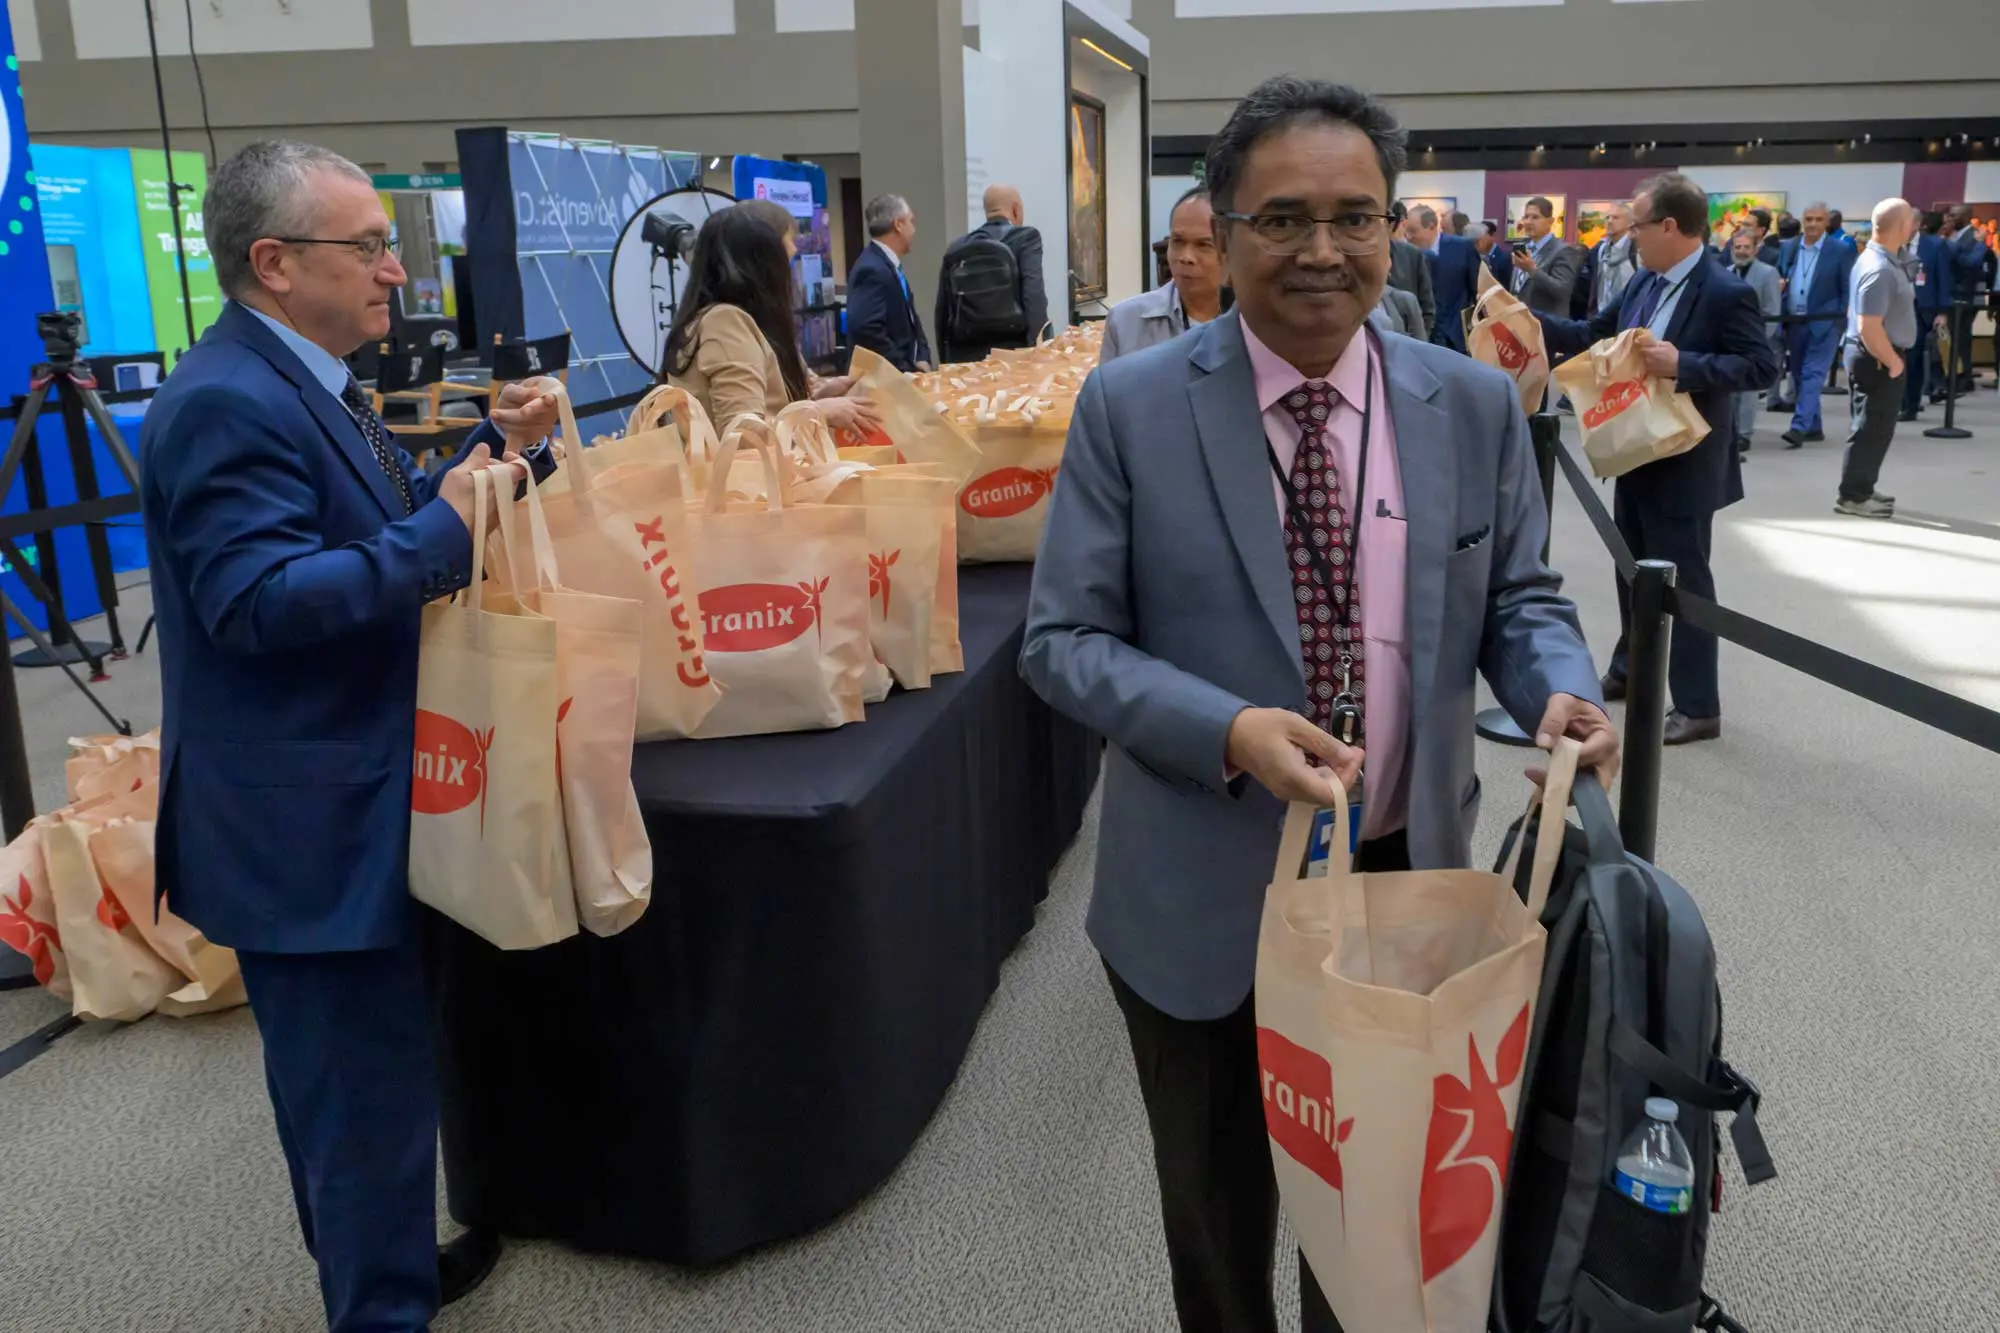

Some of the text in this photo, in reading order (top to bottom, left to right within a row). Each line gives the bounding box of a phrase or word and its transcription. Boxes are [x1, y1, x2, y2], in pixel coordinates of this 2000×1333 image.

[968, 478, 1034, 508] Granix
[413, 743, 467, 787] nix
[1262, 1069, 1338, 1153] rani
